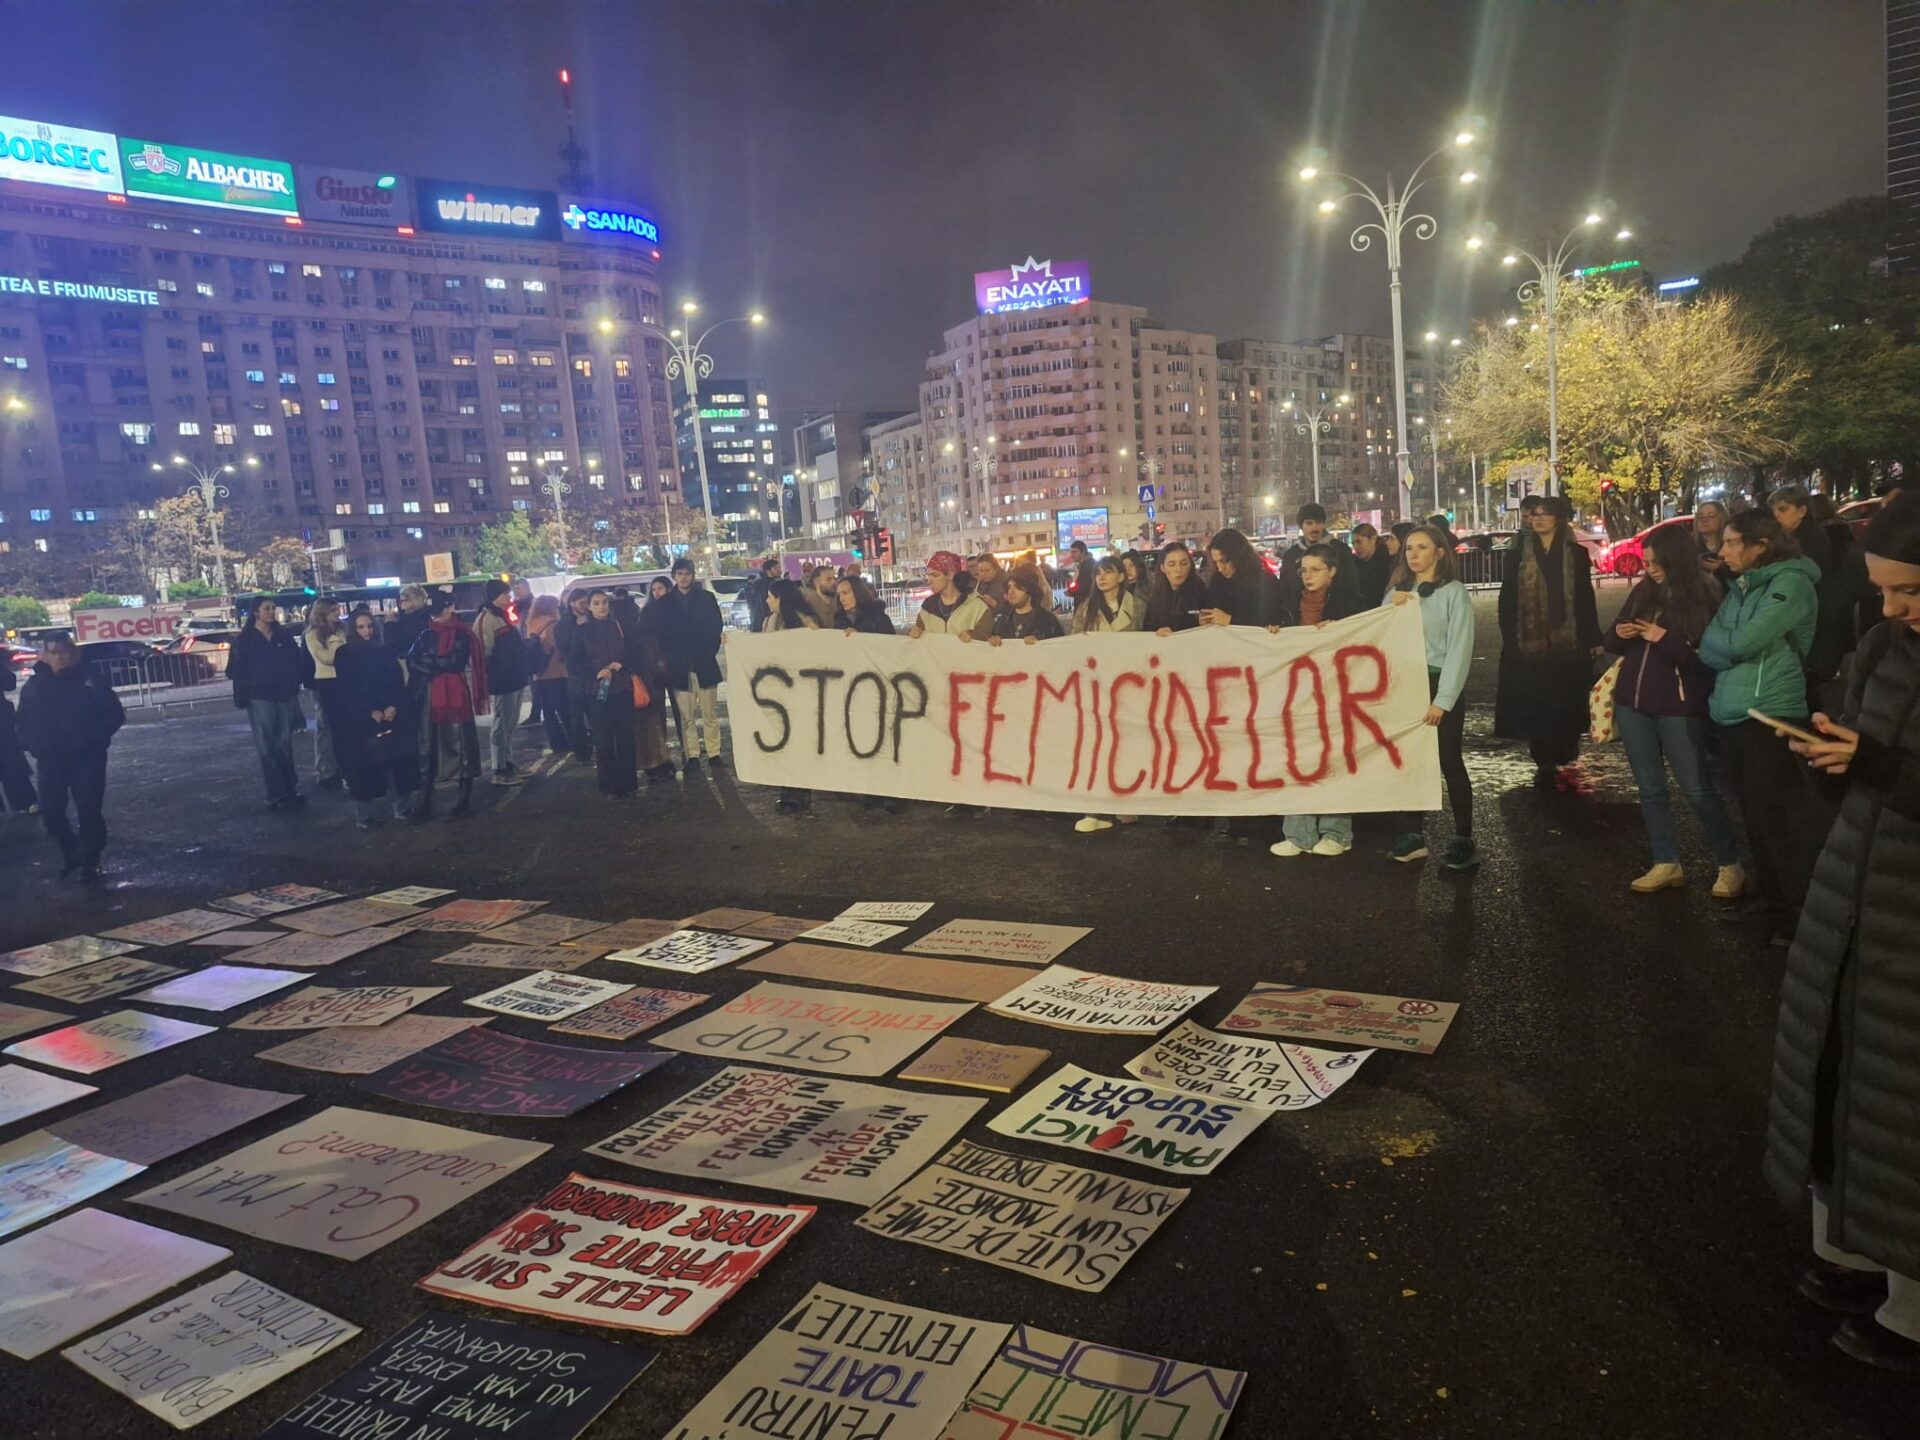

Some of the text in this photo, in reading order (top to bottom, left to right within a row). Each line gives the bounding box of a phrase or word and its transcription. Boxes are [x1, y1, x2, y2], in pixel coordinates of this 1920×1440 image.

[186, 157, 291, 196] ALBACHER
[340, 204, 390, 219] Natura
[438, 193, 540, 226] winner
[586, 210, 660, 243] SANADOR
[39, 279, 49, 295] E
[54, 281, 159, 306] FRUMUSETE
[986, 277, 1081, 303] ENAYATI
[1047, 296, 1069, 305] CITY
[750, 644, 1403, 796] STOP FEMICIDELOR
[1005, 997, 1168, 1026] NU MAI VREM
[1094, 986, 1134, 1000] ANI
[1112, 999, 1130, 1010] DE
[724, 994, 958, 1032] FEMICIDELOR
[696, 1024, 871, 1064] STOP
[1158, 1039, 1209, 1065] SUNT
[1205, 1069, 1239, 1085] TE
[1240, 1060, 1280, 1075] EU
[1248, 1076, 1290, 1092] EU
[676, 1072, 745, 1105] TRECE
[1058, 1077, 1243, 1122] SUPORT
[1220, 1086, 1257, 1102] TE
[1269, 1093, 1312, 1106] EU
[632, 1072, 782, 1159] FEMEILE MOR 51
[1045, 1091, 1227, 1140] NU MAI
[697, 1103, 808, 1169] FEMICIDE
[801, 1123, 887, 1182] FEMICIDE
[838, 1114, 927, 1177] DIASPORA
[933, 1143, 1178, 1217] ASTA NU E DREPTATE
[275, 1183, 421, 1243] Cât
[669, 1206, 796, 1248] APERE
[1040, 1213, 1149, 1252] SUNT
[859, 1195, 1121, 1285] SUTE DE FEMEI
[438, 1252, 693, 1317] LEGILE SUNT
[777, 1295, 977, 1367] FEMEILE!
[84, 1330, 234, 1418] BAD BITCHES
[467, 1373, 532, 1398] MAI
[779, 1347, 927, 1409] TOATE
[1000, 1323, 1245, 1411] MOR
[358, 1376, 532, 1433] MAMEI TALE
[537, 1383, 591, 1408] NU
[723, 1387, 897, 1440] PENTRU
